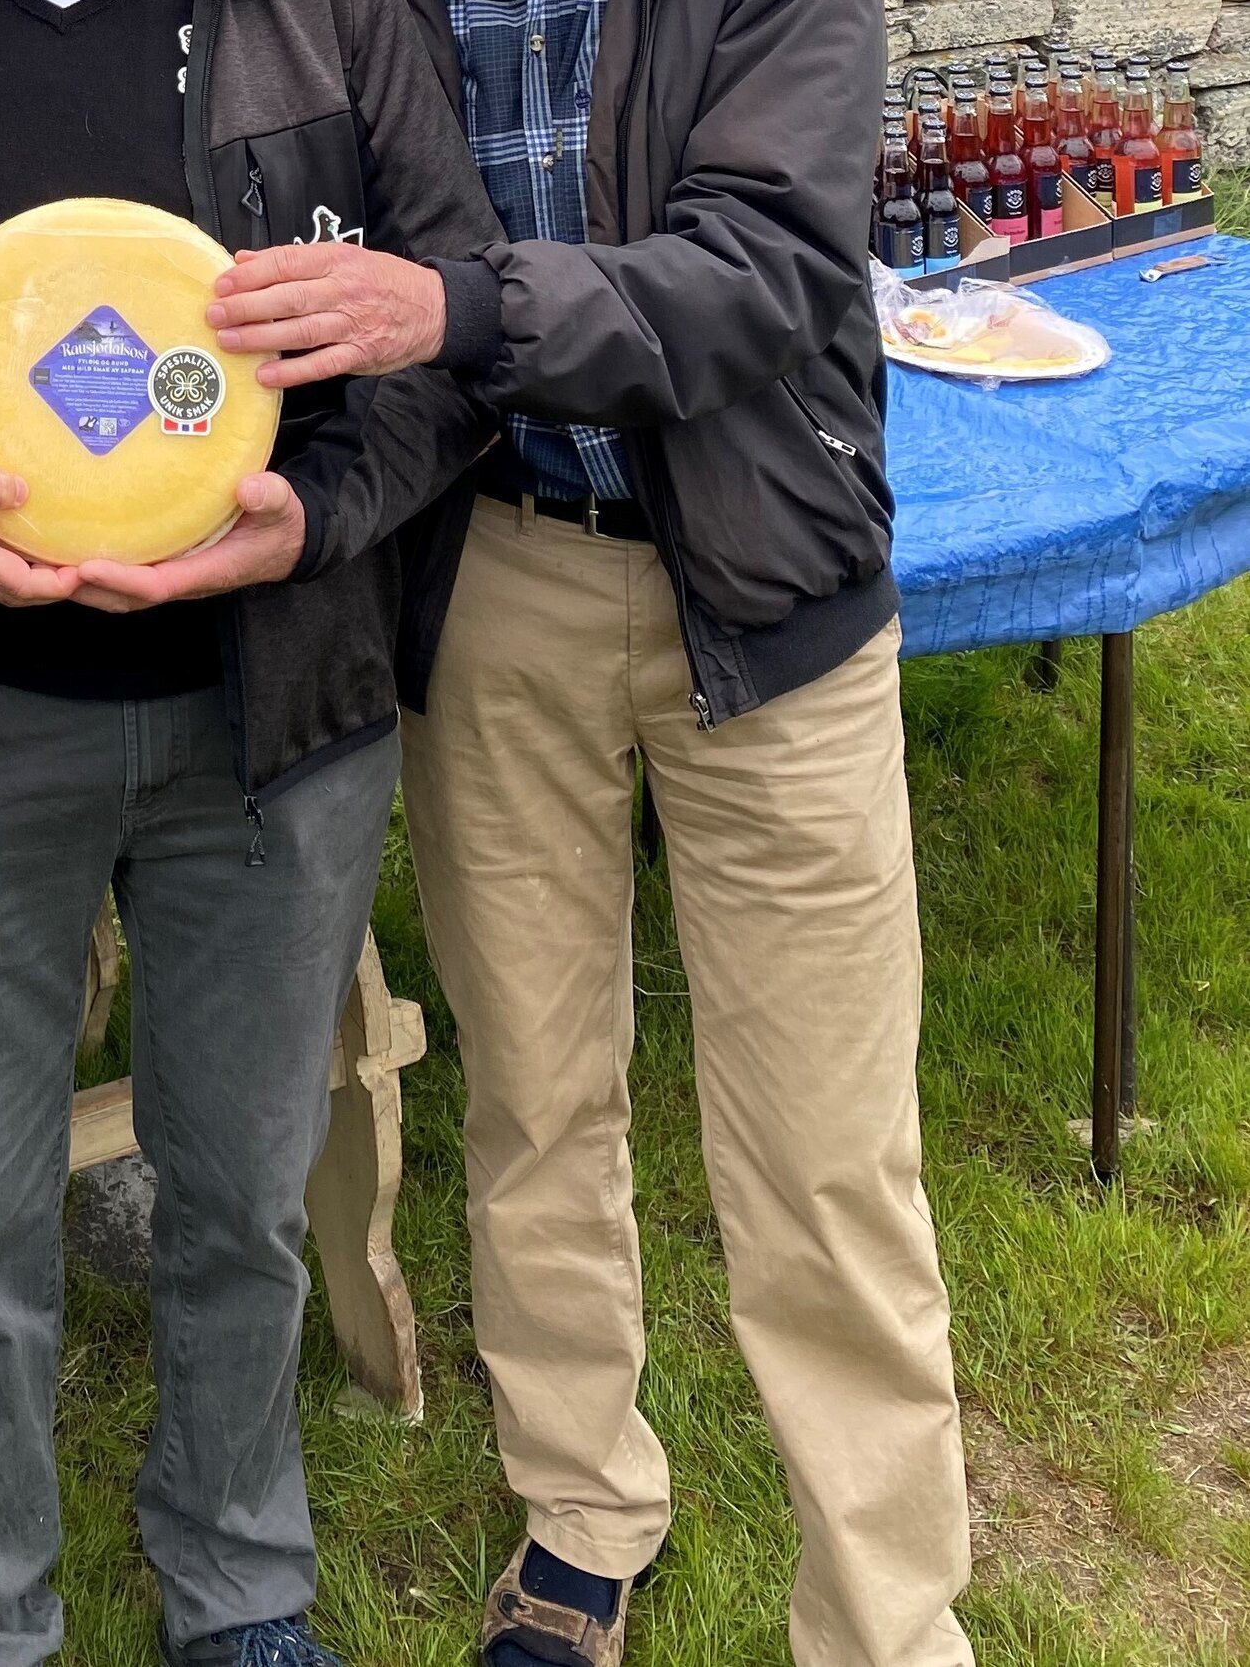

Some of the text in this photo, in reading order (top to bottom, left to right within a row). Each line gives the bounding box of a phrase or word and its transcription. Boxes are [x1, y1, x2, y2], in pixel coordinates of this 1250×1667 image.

[77, 358, 100, 366] FYLDIG
[158, 354, 216, 380] SPESIALITET
[160, 395, 213, 417] UNIK SMAK
